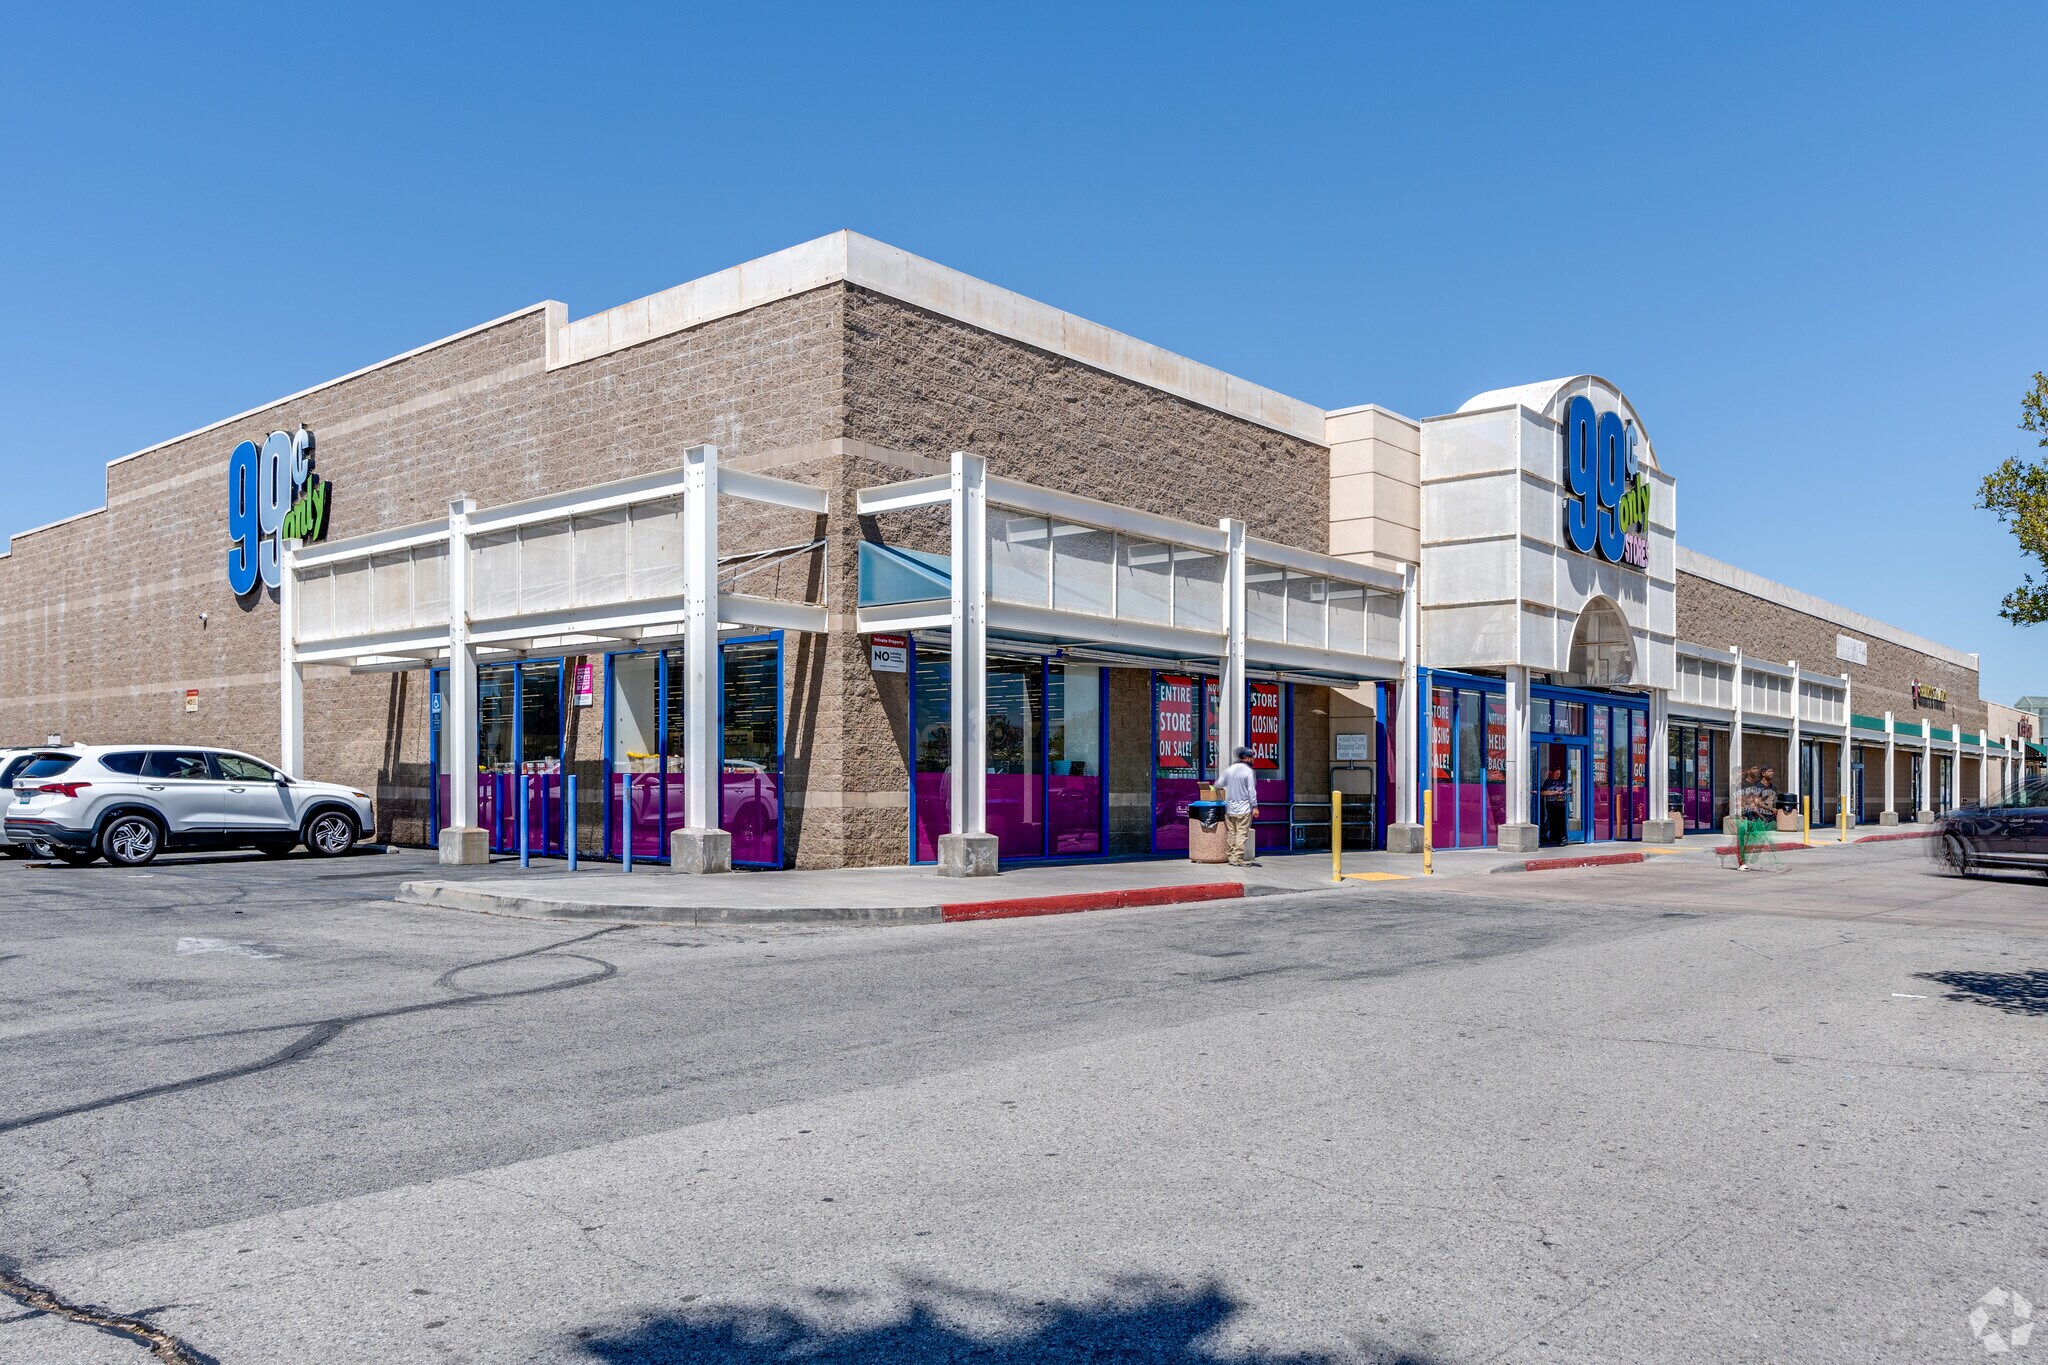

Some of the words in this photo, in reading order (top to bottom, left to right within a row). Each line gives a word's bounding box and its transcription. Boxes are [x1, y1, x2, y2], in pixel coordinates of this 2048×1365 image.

[282, 472, 326, 542] only
[1619, 471, 1650, 534] only
[1624, 531, 1650, 569] STORES
[874, 651, 890, 661] NO
[1160, 685, 1191, 703] ENTIRE
[1252, 692, 1277, 708] STORE
[1432, 705, 1449, 719] TORE
[1160, 711, 1191, 732] STORE
[1251, 715, 1278, 734] CLOSING
[1160, 740, 1171, 756] ON
[1173, 740, 1192, 757] SALE!
[1251, 742, 1278, 760] SALE!
[1337, 742, 1355, 752] Shopping
[1355, 742, 1366, 750] Carts
[1488, 733, 1506, 751] HELD
[1432, 753, 1450, 769] ALE!
[1633, 763, 1646, 777] GO!
